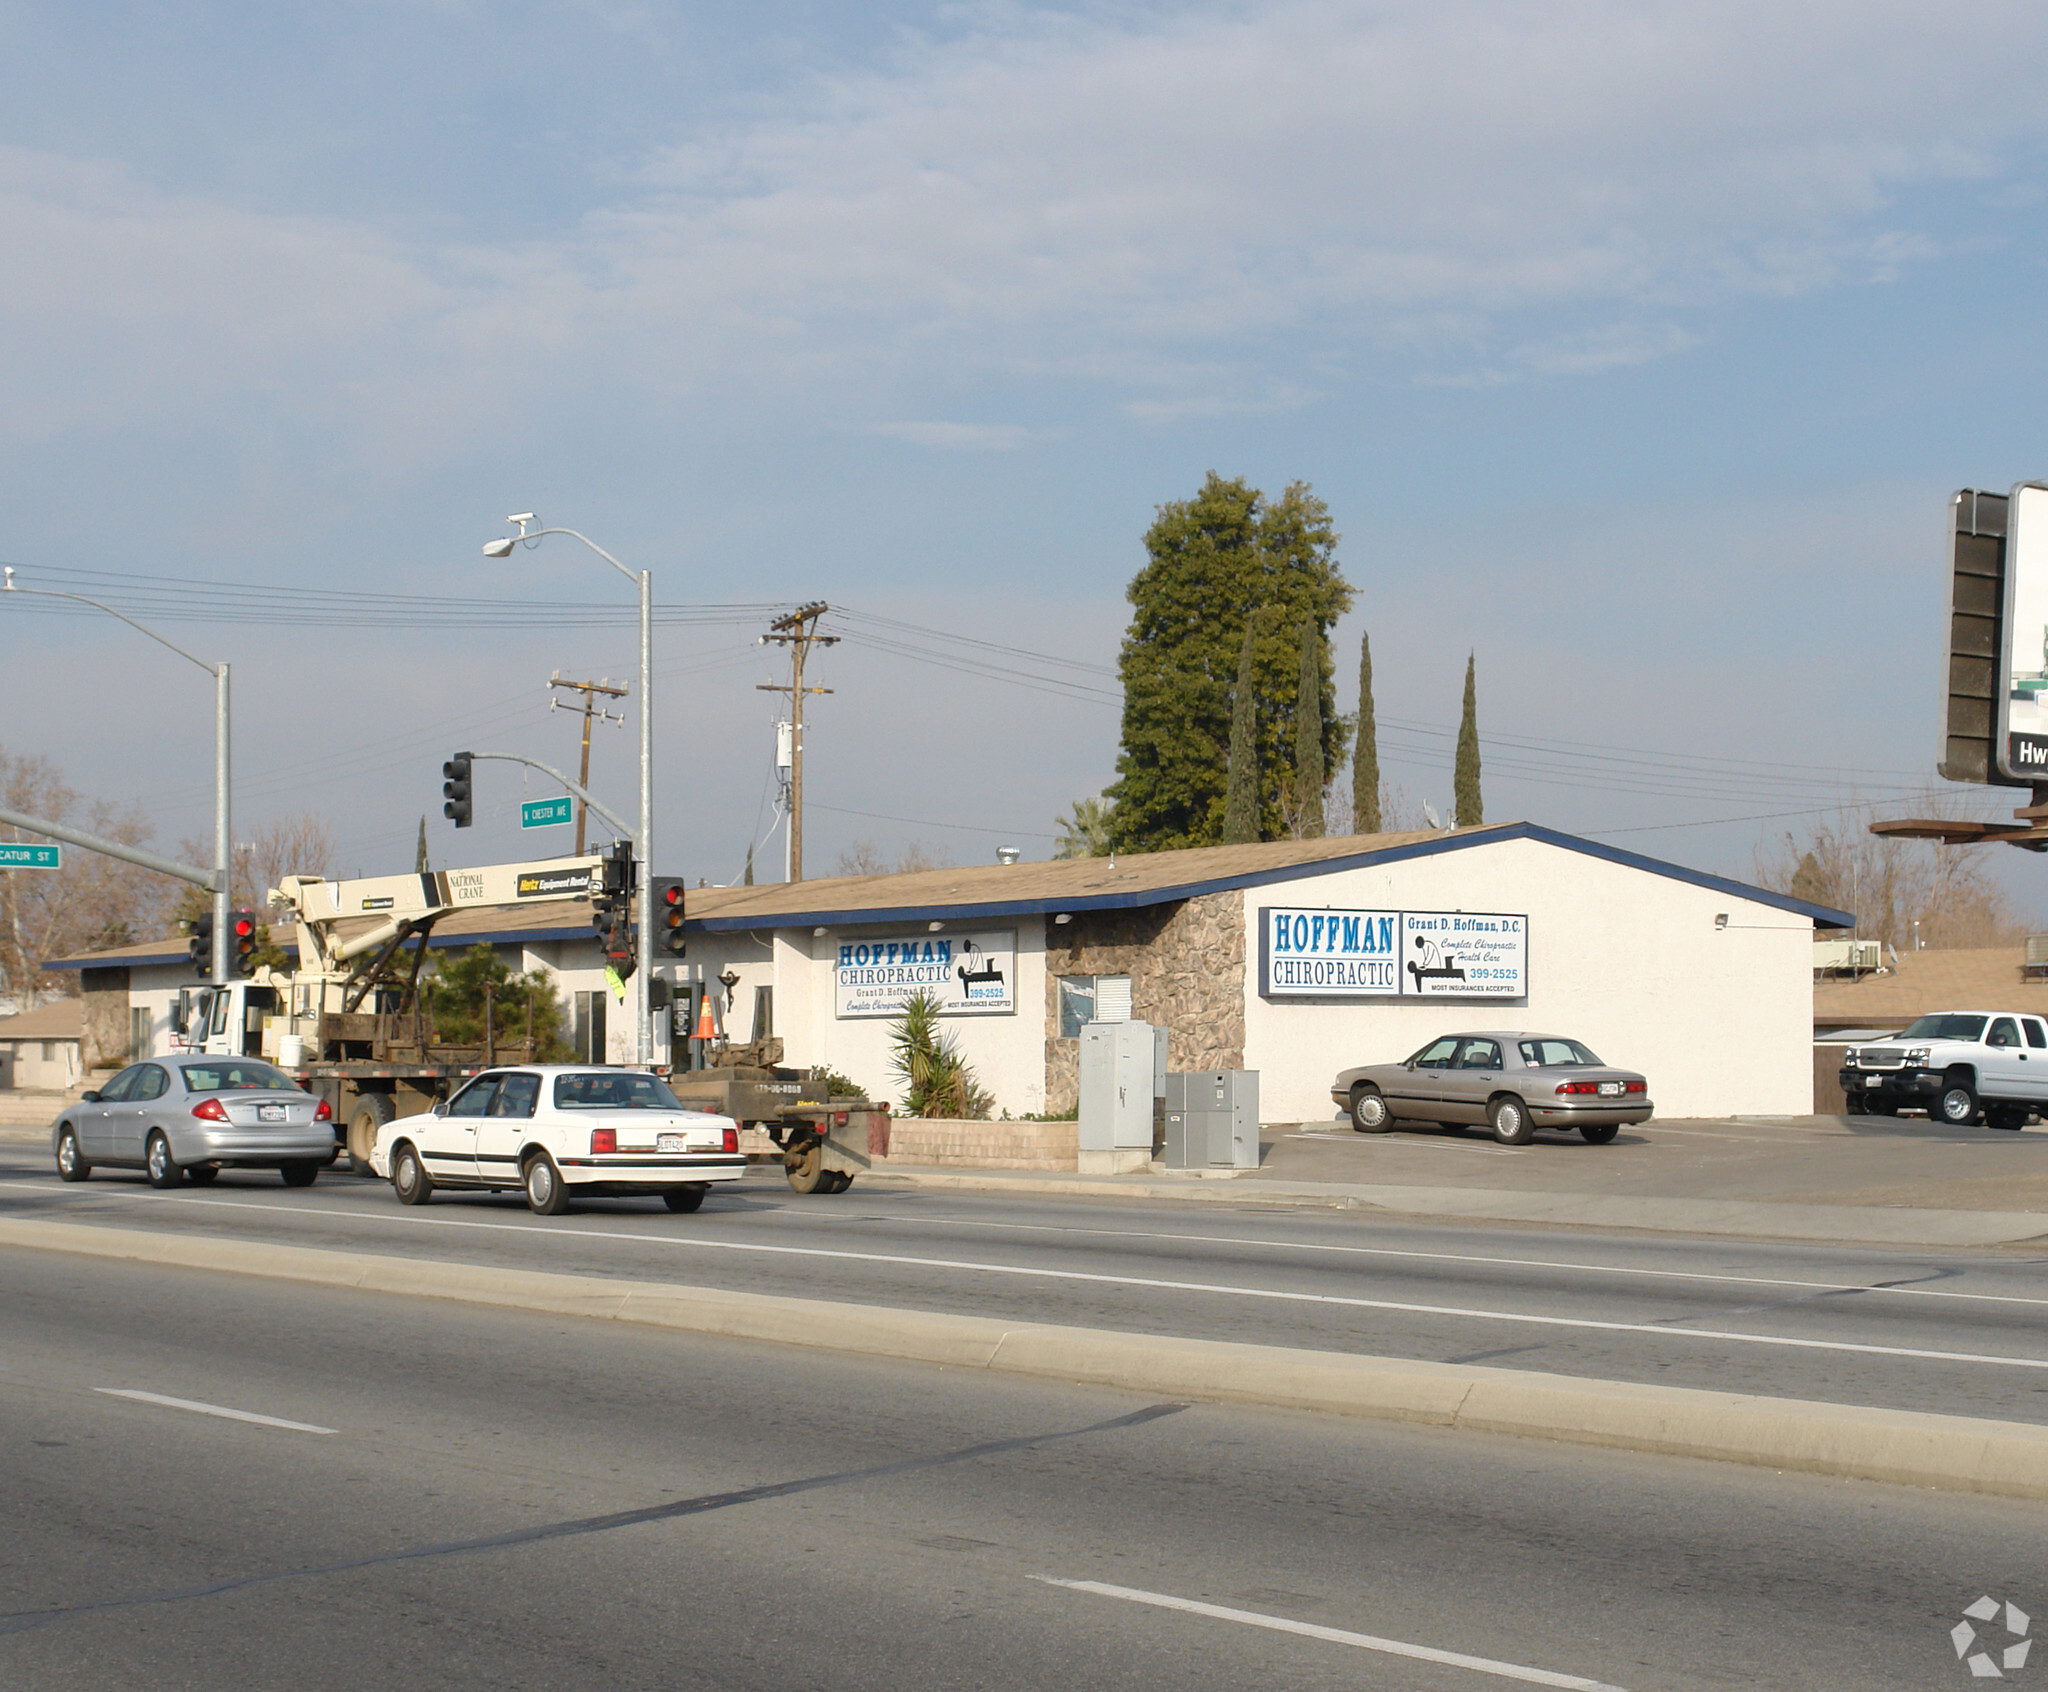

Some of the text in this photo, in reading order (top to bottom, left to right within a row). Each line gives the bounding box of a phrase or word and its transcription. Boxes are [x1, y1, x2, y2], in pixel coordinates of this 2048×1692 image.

[2020, 741, 2048, 764] Hw
[532, 807, 553, 819] CHESTER
[557, 805, 566, 816] AVE
[37, 851, 50, 861] ST
[450, 873, 484, 888] NATIONAL
[520, 879, 539, 892] Hertz
[539, 877, 570, 890] Equipment
[458, 886, 484, 899] CRANE
[1408, 917, 1437, 930] Grant
[1441, 918, 1450, 930] D.
[1502, 919, 1521, 933] D.C.
[1274, 914, 1394, 953] HOFFMAN
[1441, 938, 1517, 951] Complete Chiropractic
[839, 940, 952, 967] HOFFMAN
[1457, 951, 1501, 962] Health Care
[840, 965, 952, 985] CHIROPRACTIC
[1274, 960, 1394, 985] CHIROPRACTIC
[1470, 968, 1518, 979] 399-2525
[856, 988, 878, 997] Grant
[970, 987, 1004, 998] 399-2525
[1431, 984, 1448, 992] MOST
[1486, 985, 1515, 993] ACCEPTED
